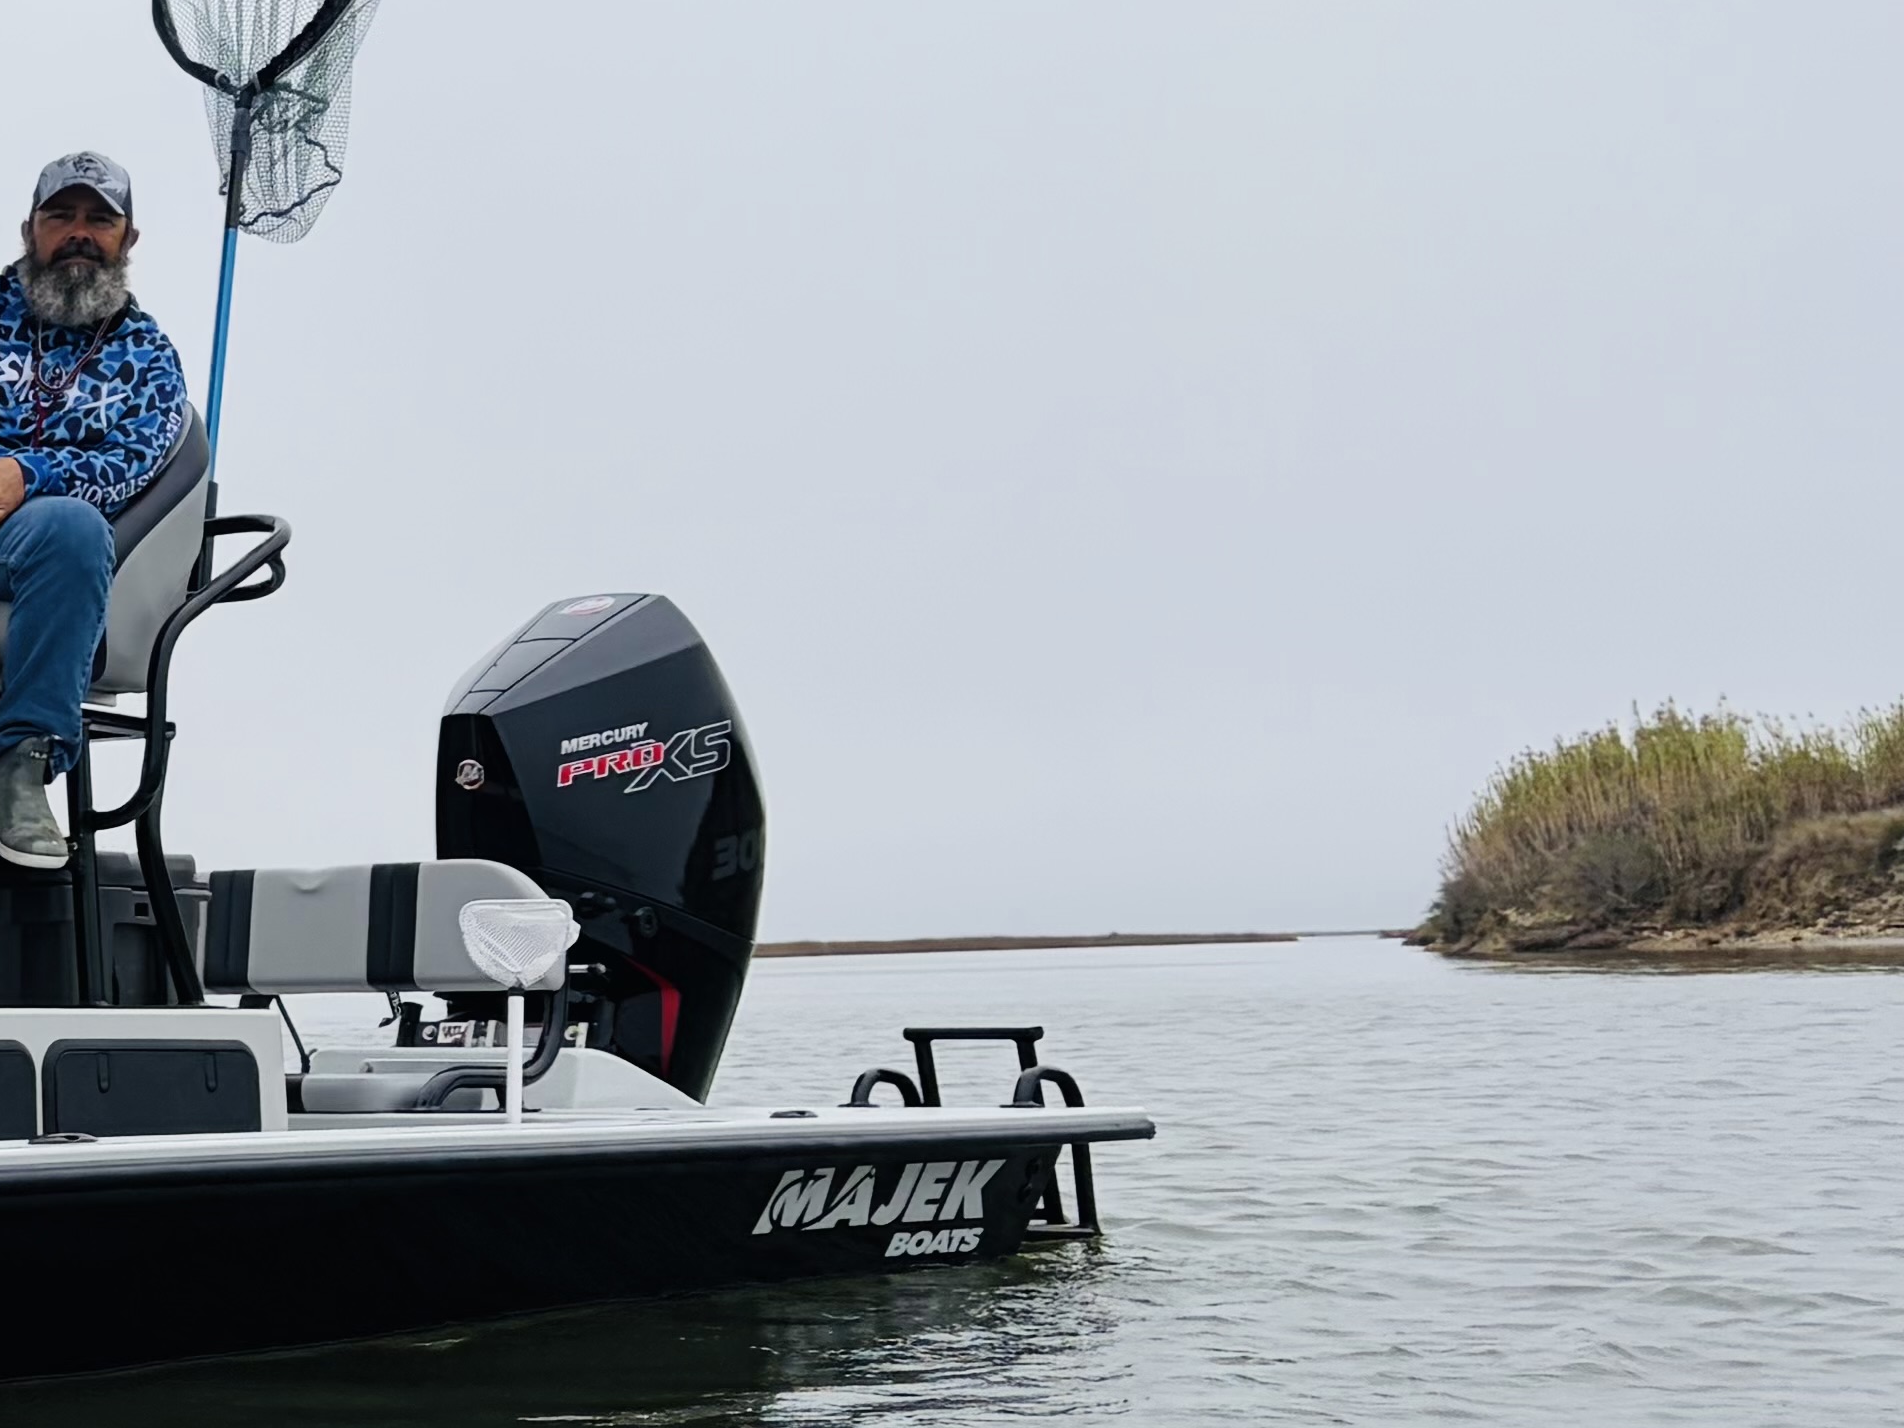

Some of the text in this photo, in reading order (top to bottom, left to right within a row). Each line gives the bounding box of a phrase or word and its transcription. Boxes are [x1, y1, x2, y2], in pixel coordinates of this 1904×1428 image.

[560, 722, 649, 755] MERCURY
[711, 827, 761, 882] 30
[751, 1158, 1007, 1235] MAJEK
[884, 1227, 985, 1258] BOATS
